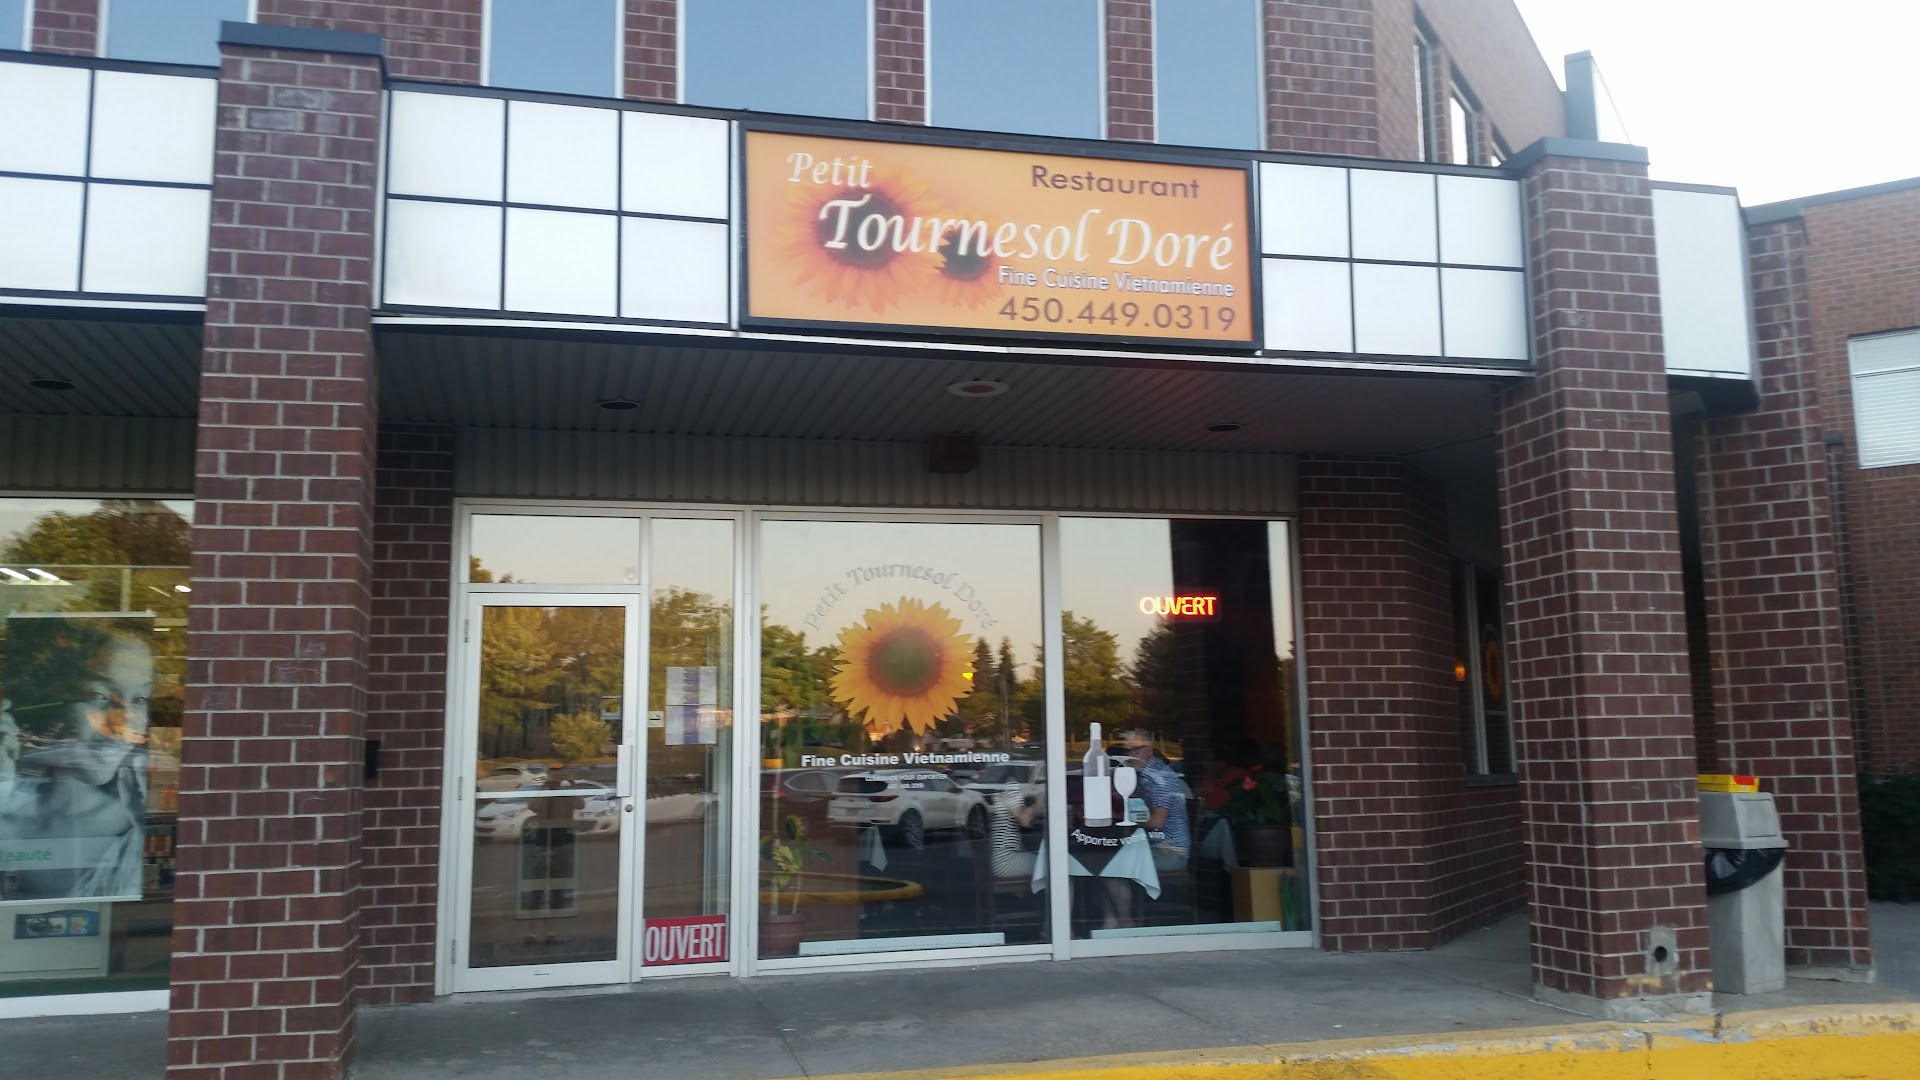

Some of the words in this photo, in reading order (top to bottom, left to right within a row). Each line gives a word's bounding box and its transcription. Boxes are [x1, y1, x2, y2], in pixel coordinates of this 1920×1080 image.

[786, 152, 872, 188] Petit
[1031, 164, 1200, 199] Restaurant
[818, 193, 1102, 262] Tournesol
[1106, 218, 1234, 271] Doré
[998, 265, 1038, 287] Fine
[1042, 267, 1110, 291] Cuisine
[1113, 271, 1235, 297] Vietnamienne
[998, 296, 1236, 332] 450.449.0319
[803, 582, 848, 631] Petit
[846, 563, 959, 590] Tournesol
[953, 581, 1000, 631] Doré
[1139, 596, 1217, 616] OUVERT
[801, 754, 836, 767] Fine
[839, 753, 900, 766] Cuisine
[902, 751, 1011, 765] Vietnamienne
[1070, 829, 1119, 846] Apportez
[1148, 829, 1165, 840] vin
[645, 922, 726, 962] OUVERT
